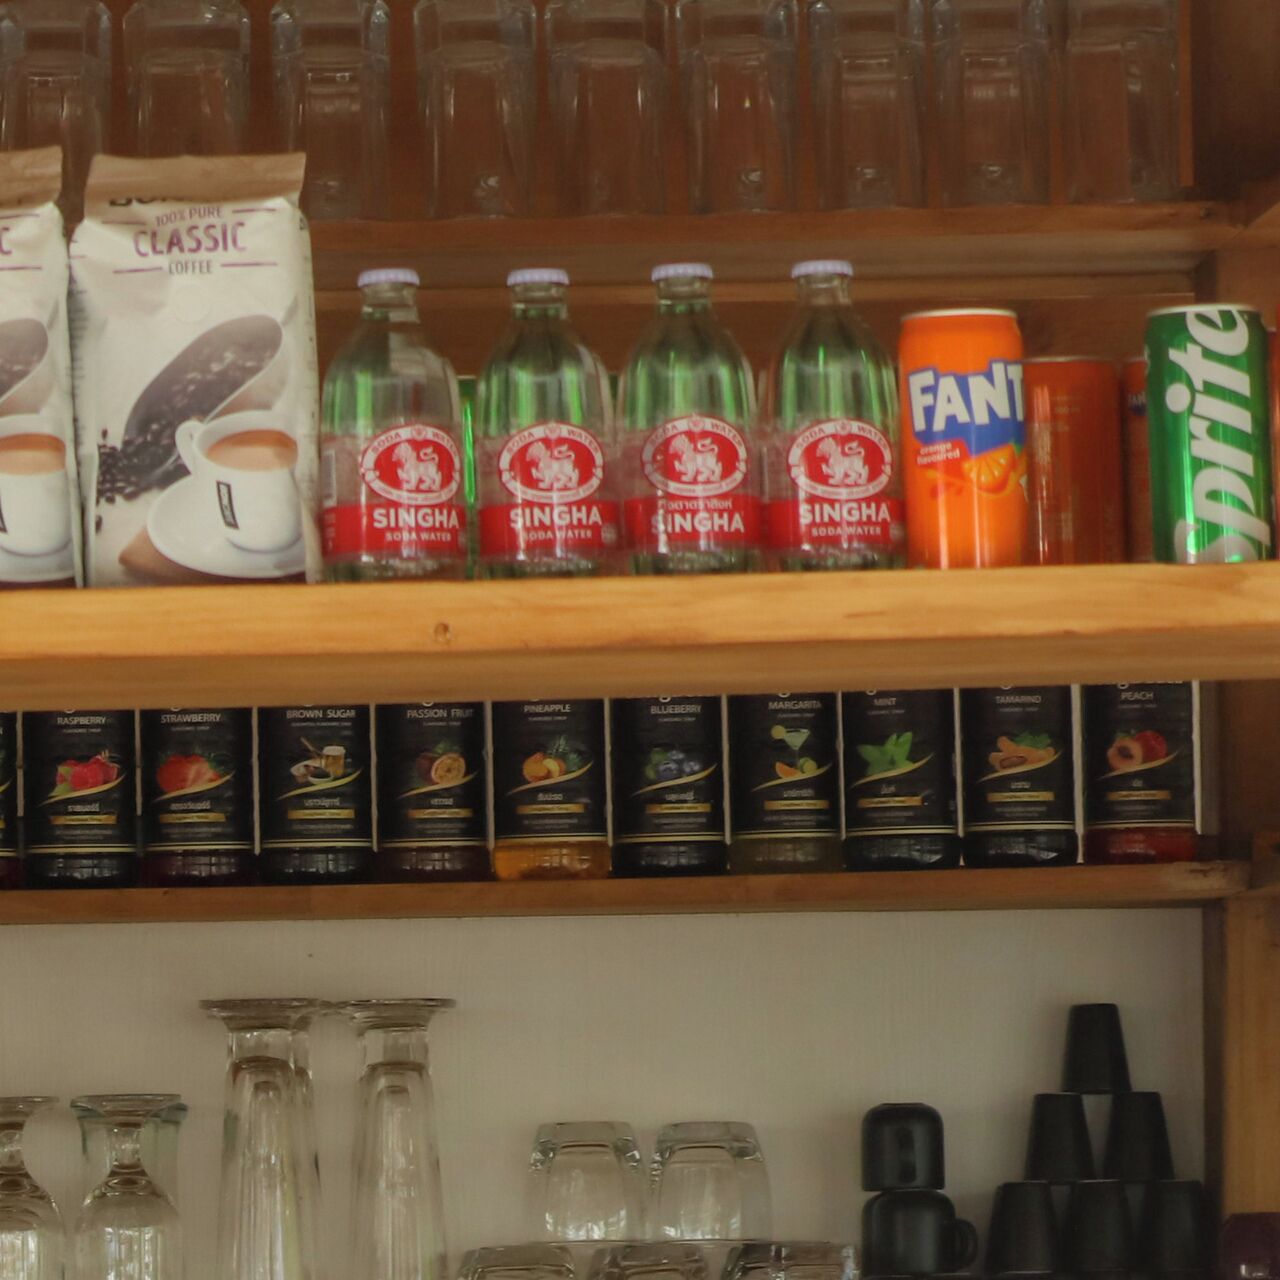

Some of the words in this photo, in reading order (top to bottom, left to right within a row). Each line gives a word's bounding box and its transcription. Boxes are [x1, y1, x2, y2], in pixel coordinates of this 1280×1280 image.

[189, 206, 223, 221] PURE
[133, 222, 247, 258] CLASSIC
[168, 260, 213, 275] COFFEE
[908, 361, 1024, 433] FANT
[796, 427, 826, 449] SODA
[920, 442, 952, 456] orange
[917, 449, 961, 465] flavoured
[373, 507, 459, 530] SINGHA
[510, 504, 602, 530] SINGHA
[800, 502, 890, 526] SINGHA
[651, 511, 744, 534] SINGHA
[385, 531, 417, 542] SODA
[420, 531, 452, 542] WATER
[556, 528, 592, 539] WATER
[811, 526, 841, 537] SODA
[845, 526, 881, 536] WATER
[996, 695, 1042, 704] TAMARIND
[1120, 691, 1154, 702] PEACH
[768, 700, 822, 710] MARGARITA
[873, 698, 897, 707] MINT
[286, 709, 323, 719] BROWN
[327, 709, 356, 719] SUGAR
[406, 709, 448, 719] PASSION
[451, 708, 474, 718] FRUIT
[523, 704, 571, 714] PINEAPPLE
[650, 704, 702, 715] BLUEBERRY
[57, 716, 106, 725] RASPBERRY
[161, 713, 221, 724] STRAWBERRY
